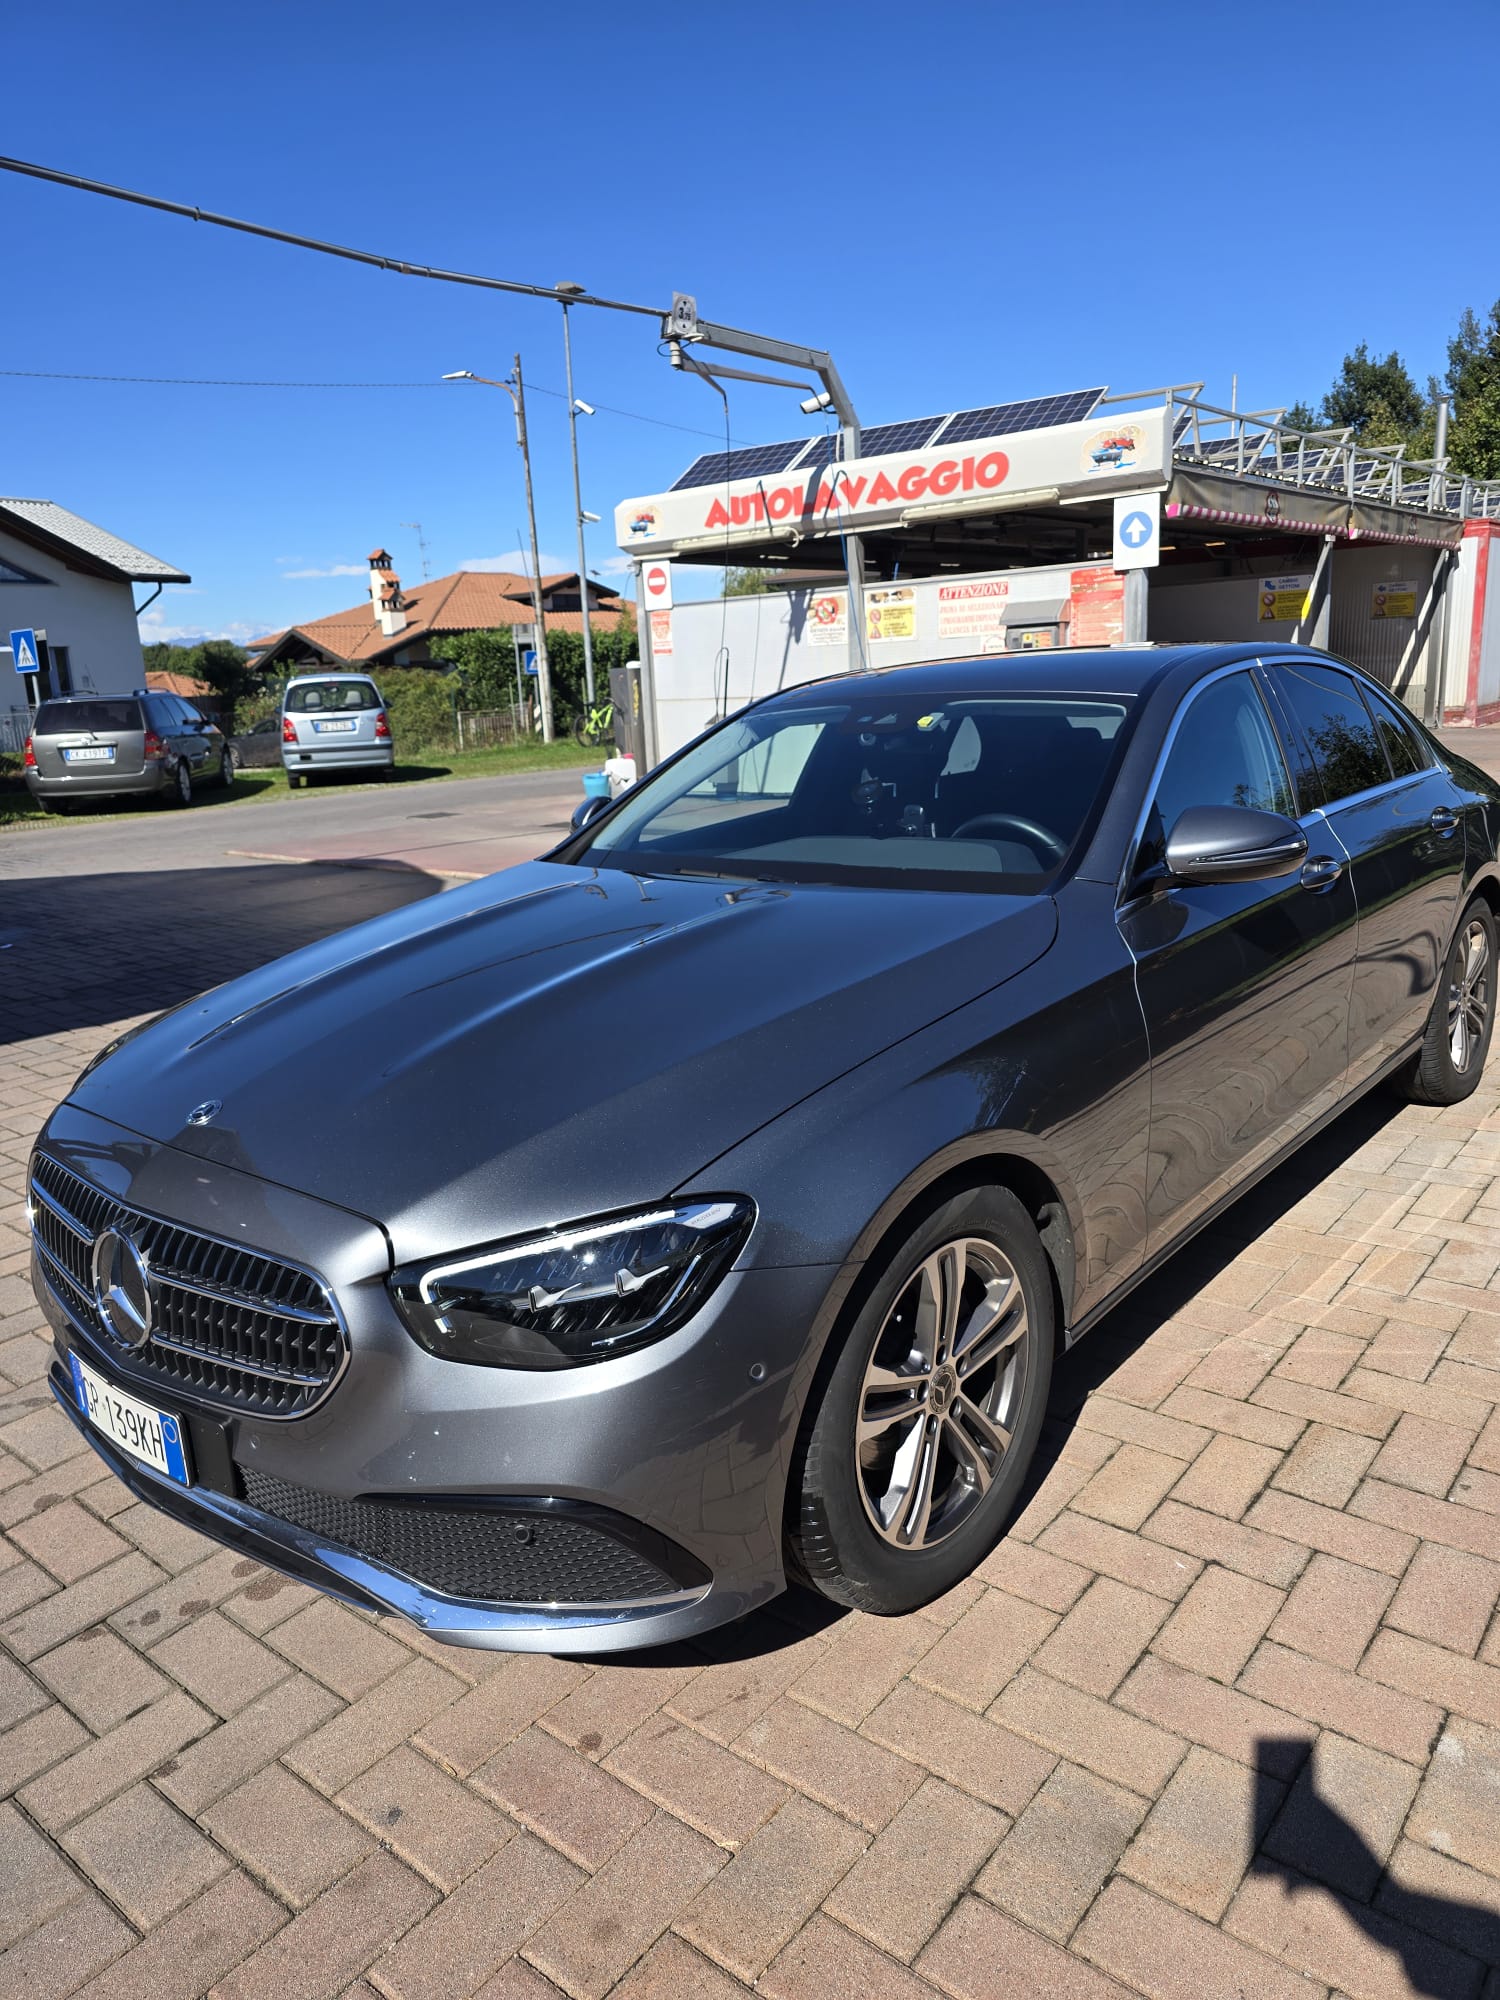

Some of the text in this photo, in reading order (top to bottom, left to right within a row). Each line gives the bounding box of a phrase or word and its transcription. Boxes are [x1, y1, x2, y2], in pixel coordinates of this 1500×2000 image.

[704, 451, 1010, 528] AUTOLAVAGGIO
[940, 583, 1007, 599] ATTENZIONE
[105, 1395, 165, 1462] 139KH
